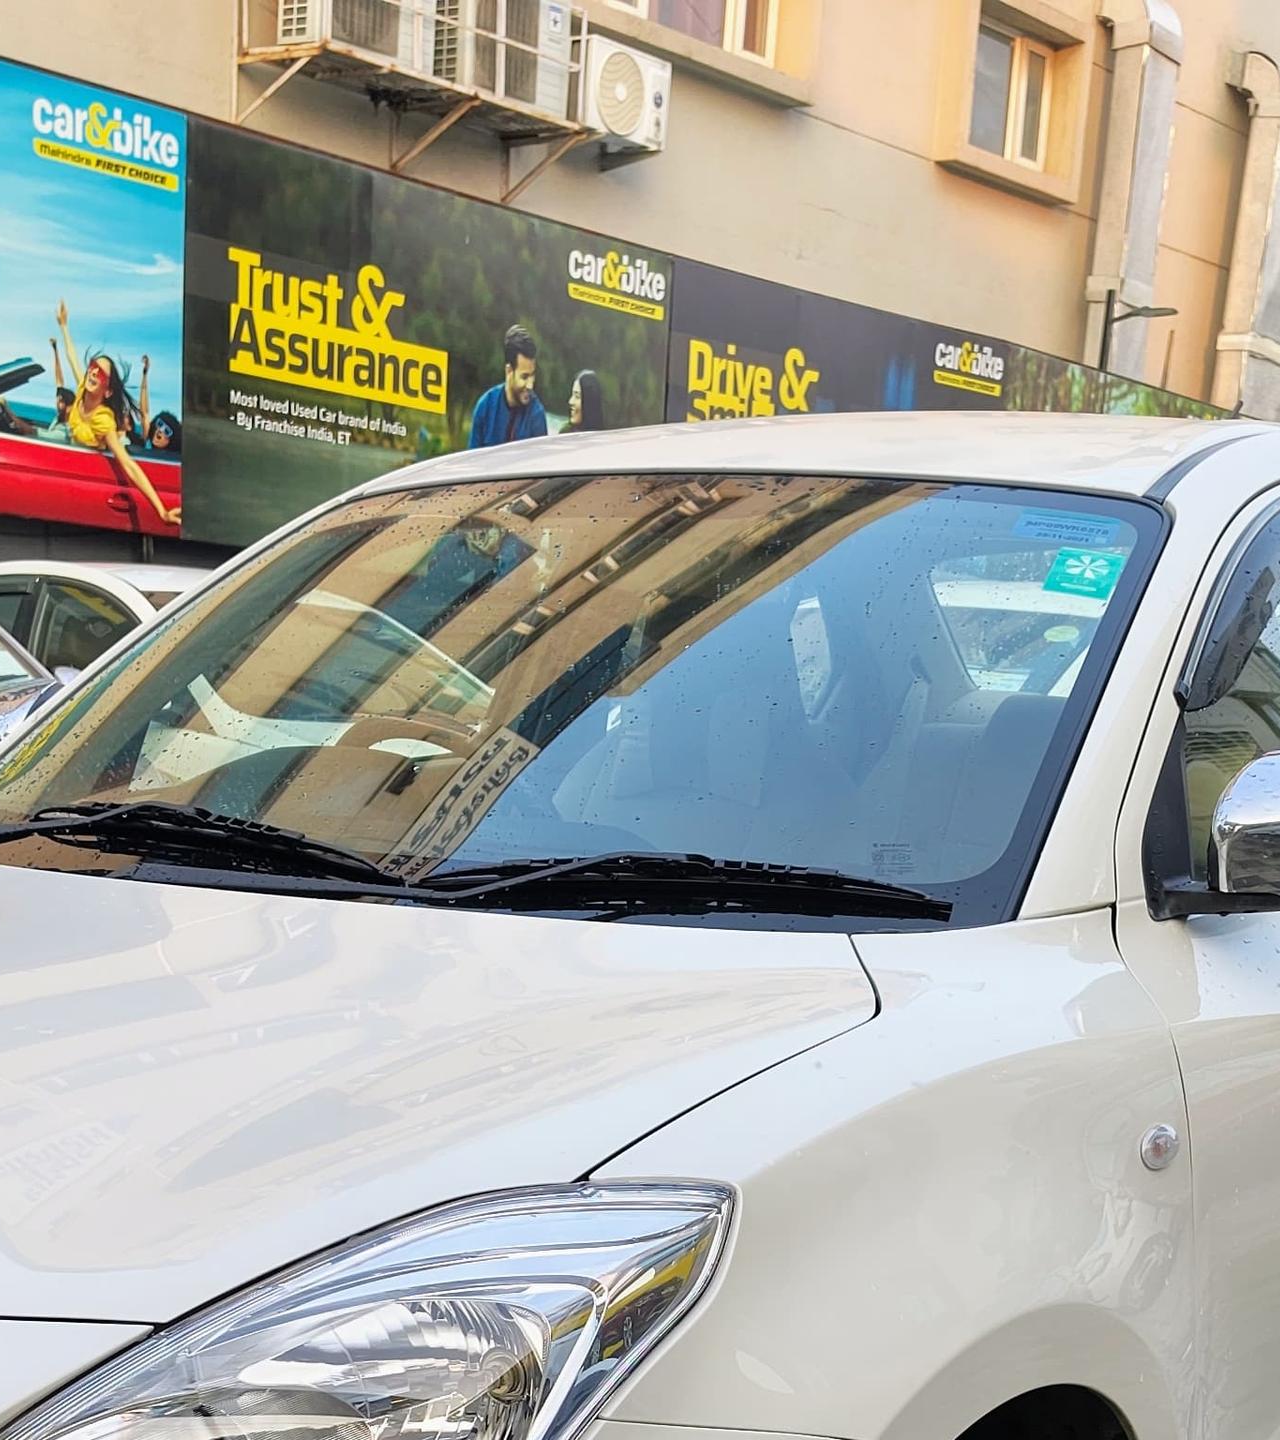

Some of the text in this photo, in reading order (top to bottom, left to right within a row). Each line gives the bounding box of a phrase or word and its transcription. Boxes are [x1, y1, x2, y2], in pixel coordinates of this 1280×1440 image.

[33, 98, 180, 168] car&bike
[39, 143, 167, 185] Mahindra FIRST CHOICE
[228, 247, 405, 340] Trust &
[568, 250, 666, 301] car&bike
[229, 307, 443, 402] Assurance
[688, 339, 773, 403] Drive
[779, 348, 820, 412] &
[935, 341, 1005, 380] car&bike
[229, 389, 407, 436] Most loved Used Car brand of India
[236, 411, 253, 431] By
[254, 415, 305, 438] Franchise
[306, 425, 336, 445] India,
[337, 431, 352, 446] ET
